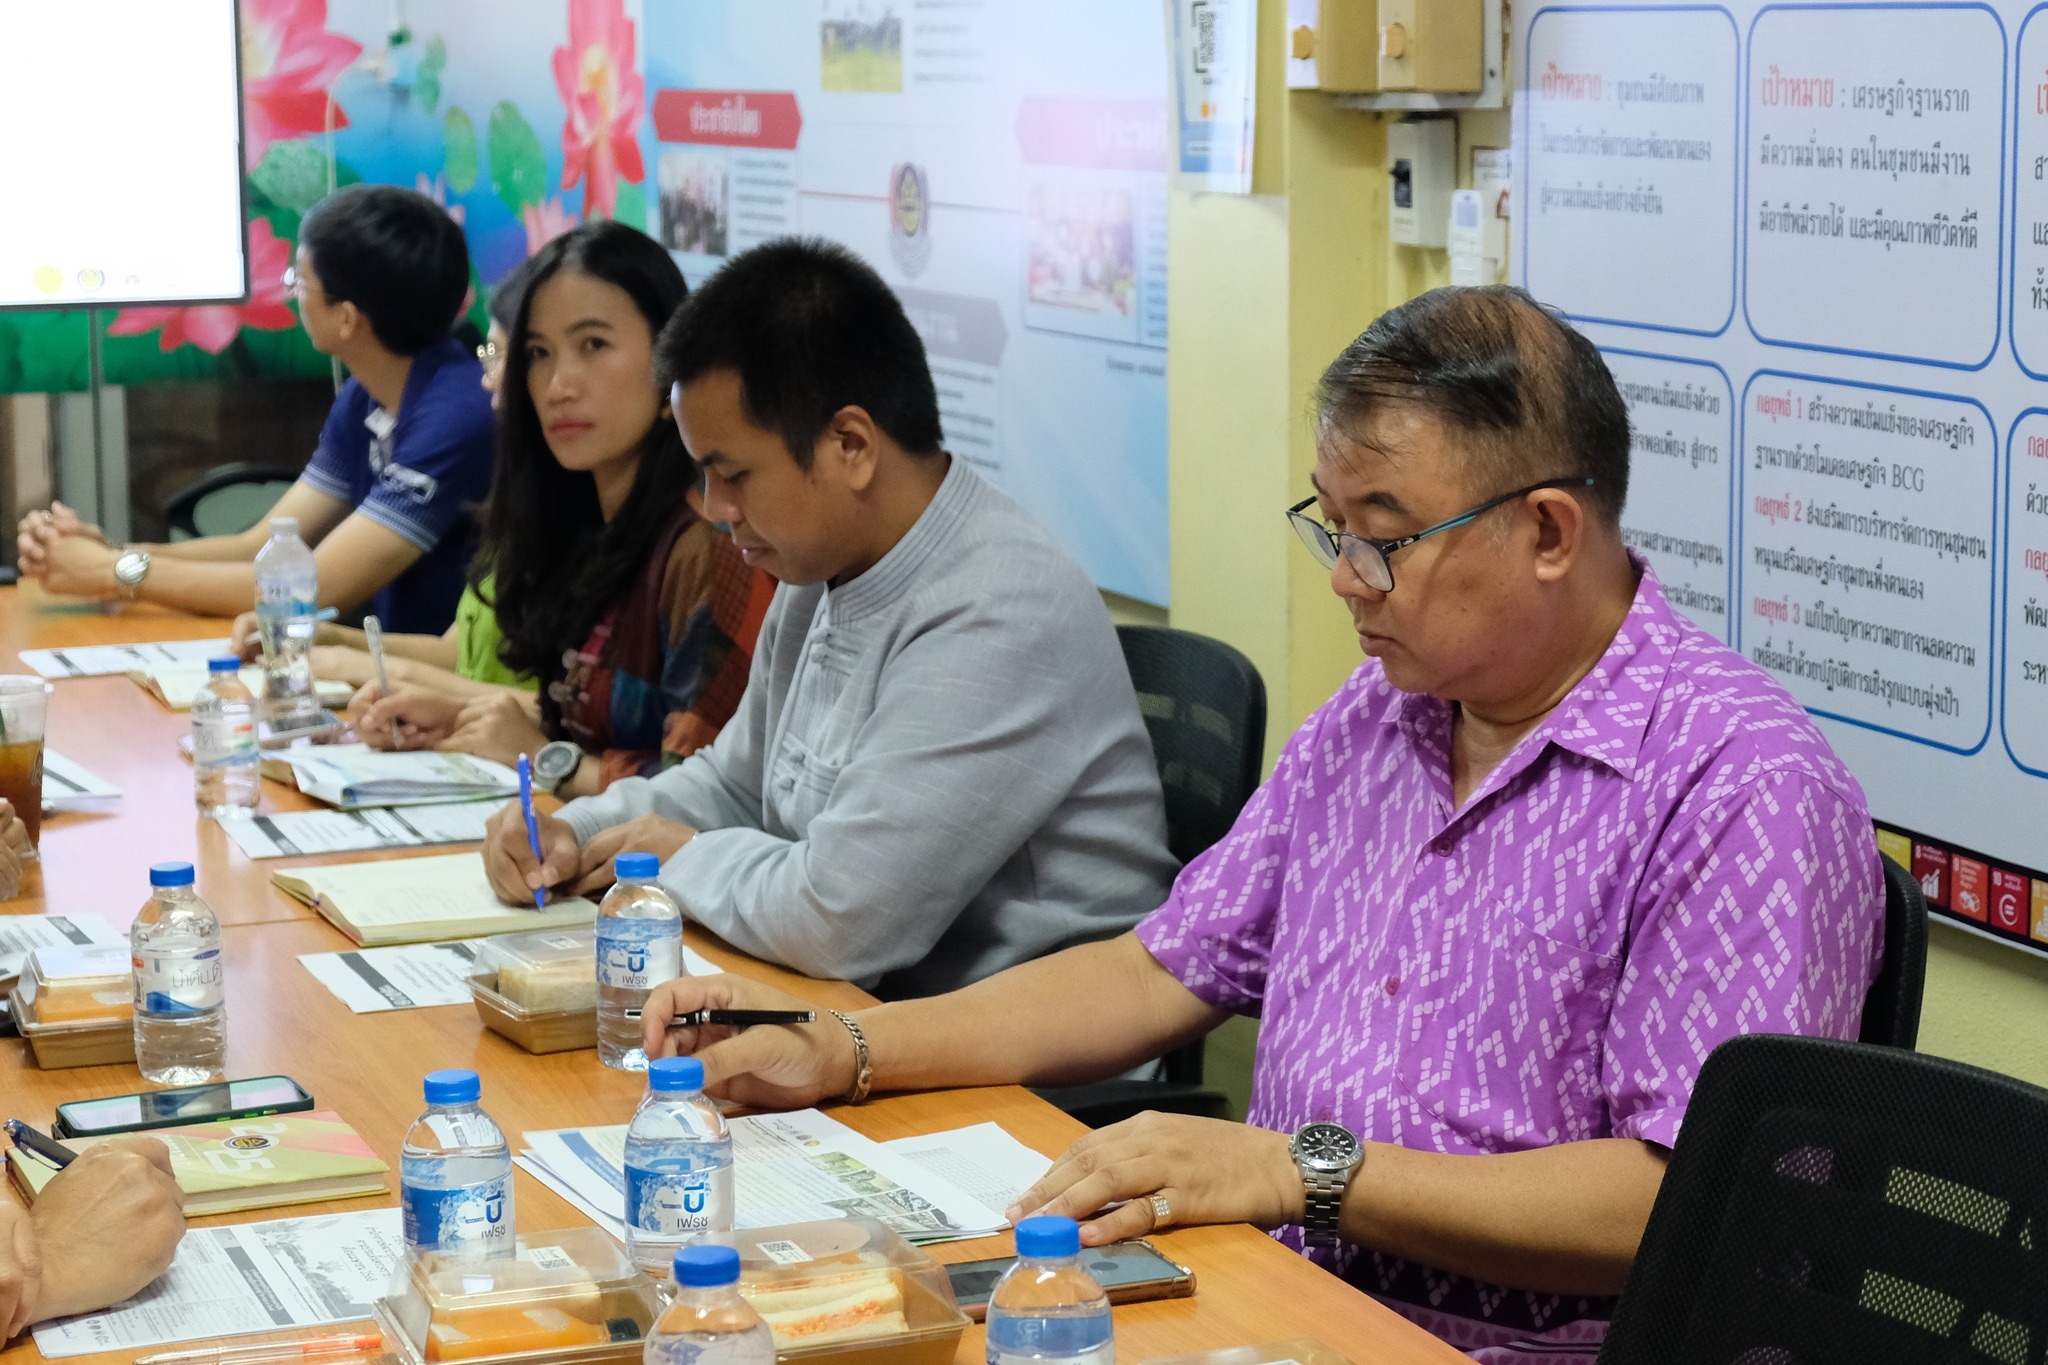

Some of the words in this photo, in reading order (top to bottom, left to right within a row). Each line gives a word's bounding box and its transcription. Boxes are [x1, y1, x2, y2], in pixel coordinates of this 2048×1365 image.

[1762, 63, 1834, 108] เป้าหมาย
[1852, 78, 1970, 117] เศรษฐกิจฐานราก
[1760, 129, 1843, 168] มีความมั่นคง
[1851, 134, 1971, 182] คนในชุมชนมีงาน
[1760, 200, 1845, 238] มีอาชีพมีรายได้
[1850, 207, 1978, 251] และมีคุณภาพชีวิตที่ดี
[1757, 390, 1792, 423] กลยุทธ์
[1797, 397, 1802, 419] 1
[1808, 395, 1975, 449] สร้างความเข้มแข็งของเศรษฐกิจ
[1892, 463, 1925, 492] BCG
[1755, 492, 1790, 526] กลยุทธ์
[1795, 500, 1802, 522] 2
[1807, 499, 1987, 562] ส่งเสริมการบริหารจัดการทุนชุมชน
[1753, 594, 1789, 627] กลยุทธ์
[1793, 602, 1800, 625] 3
[1805, 600, 1976, 667] แก้ไขปัญหาความยากจนลดความ
[622, 972, 648, 985] เฟรช
[481, 1223, 506, 1239] เฟรช
[677, 1214, 708, 1229] เฟรช
